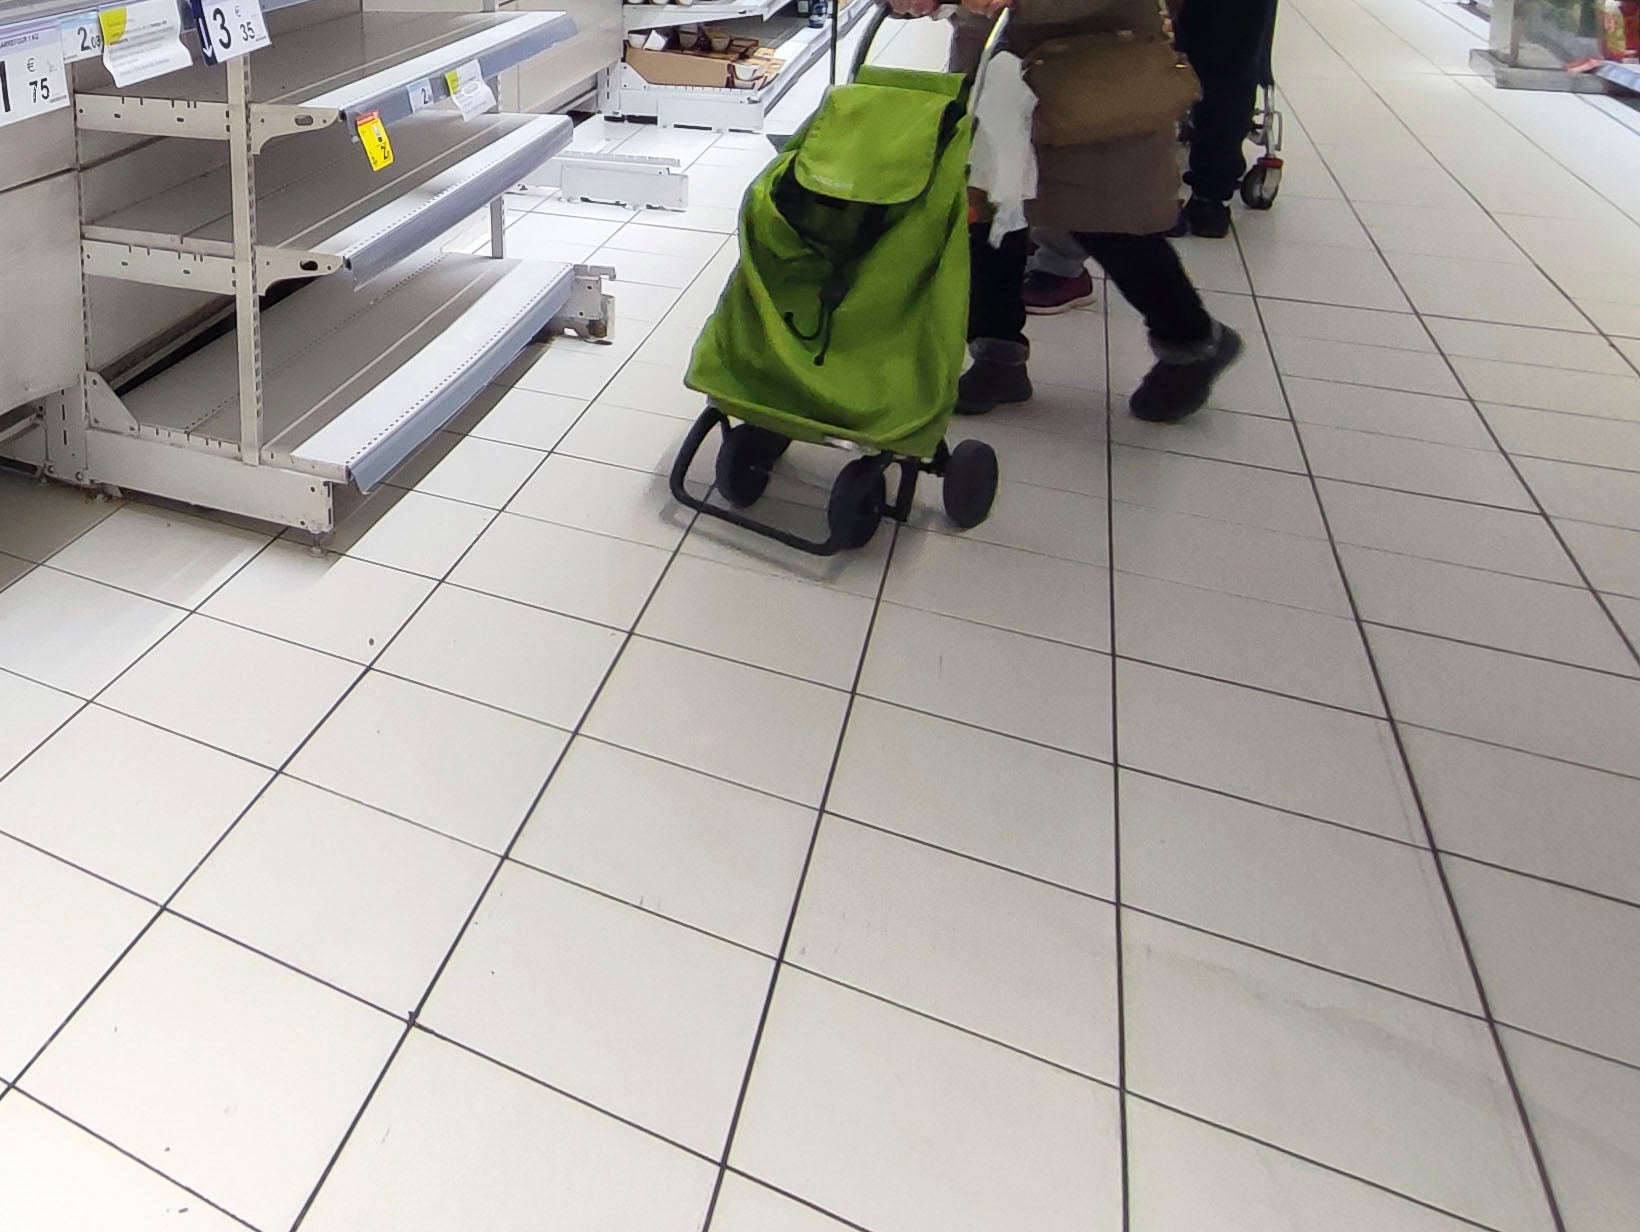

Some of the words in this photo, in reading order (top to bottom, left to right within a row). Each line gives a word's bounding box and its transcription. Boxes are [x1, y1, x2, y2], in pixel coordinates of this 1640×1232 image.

[212, 7, 232, 50] 3
[26, 57, 36, 72] €
[28, 77, 50, 104] 75
